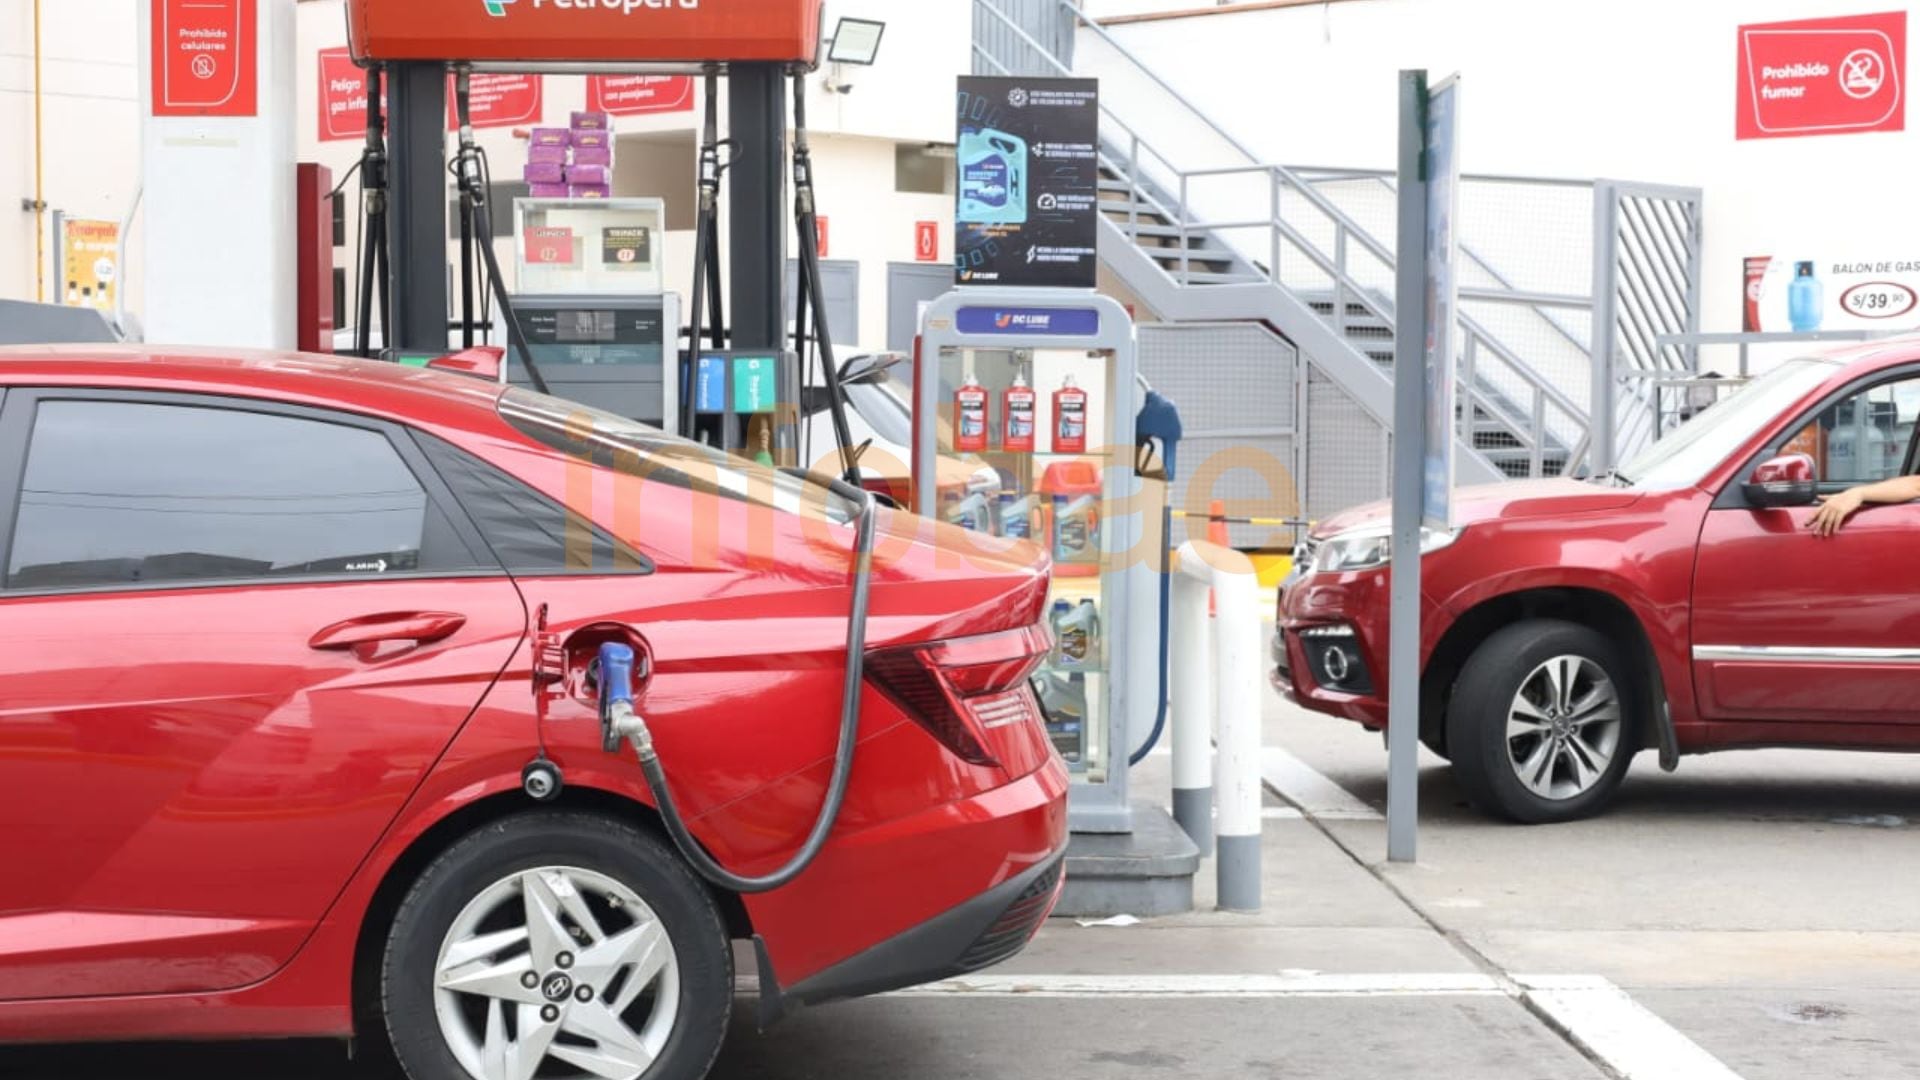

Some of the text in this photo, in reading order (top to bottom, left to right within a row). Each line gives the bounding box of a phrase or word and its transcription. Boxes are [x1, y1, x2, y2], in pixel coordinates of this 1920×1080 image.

[179, 28, 227, 38] Prohibido
[181, 41, 226, 51] celulares
[1761, 62, 1830, 80] Prohibido
[330, 76, 362, 94] Peligro
[1760, 85, 1807, 99] fumar
[330, 100, 347, 115] gas
[1832, 261, 1920, 274] BALON DE GAS
[1012, 315, 1049, 324] DC LUBE
